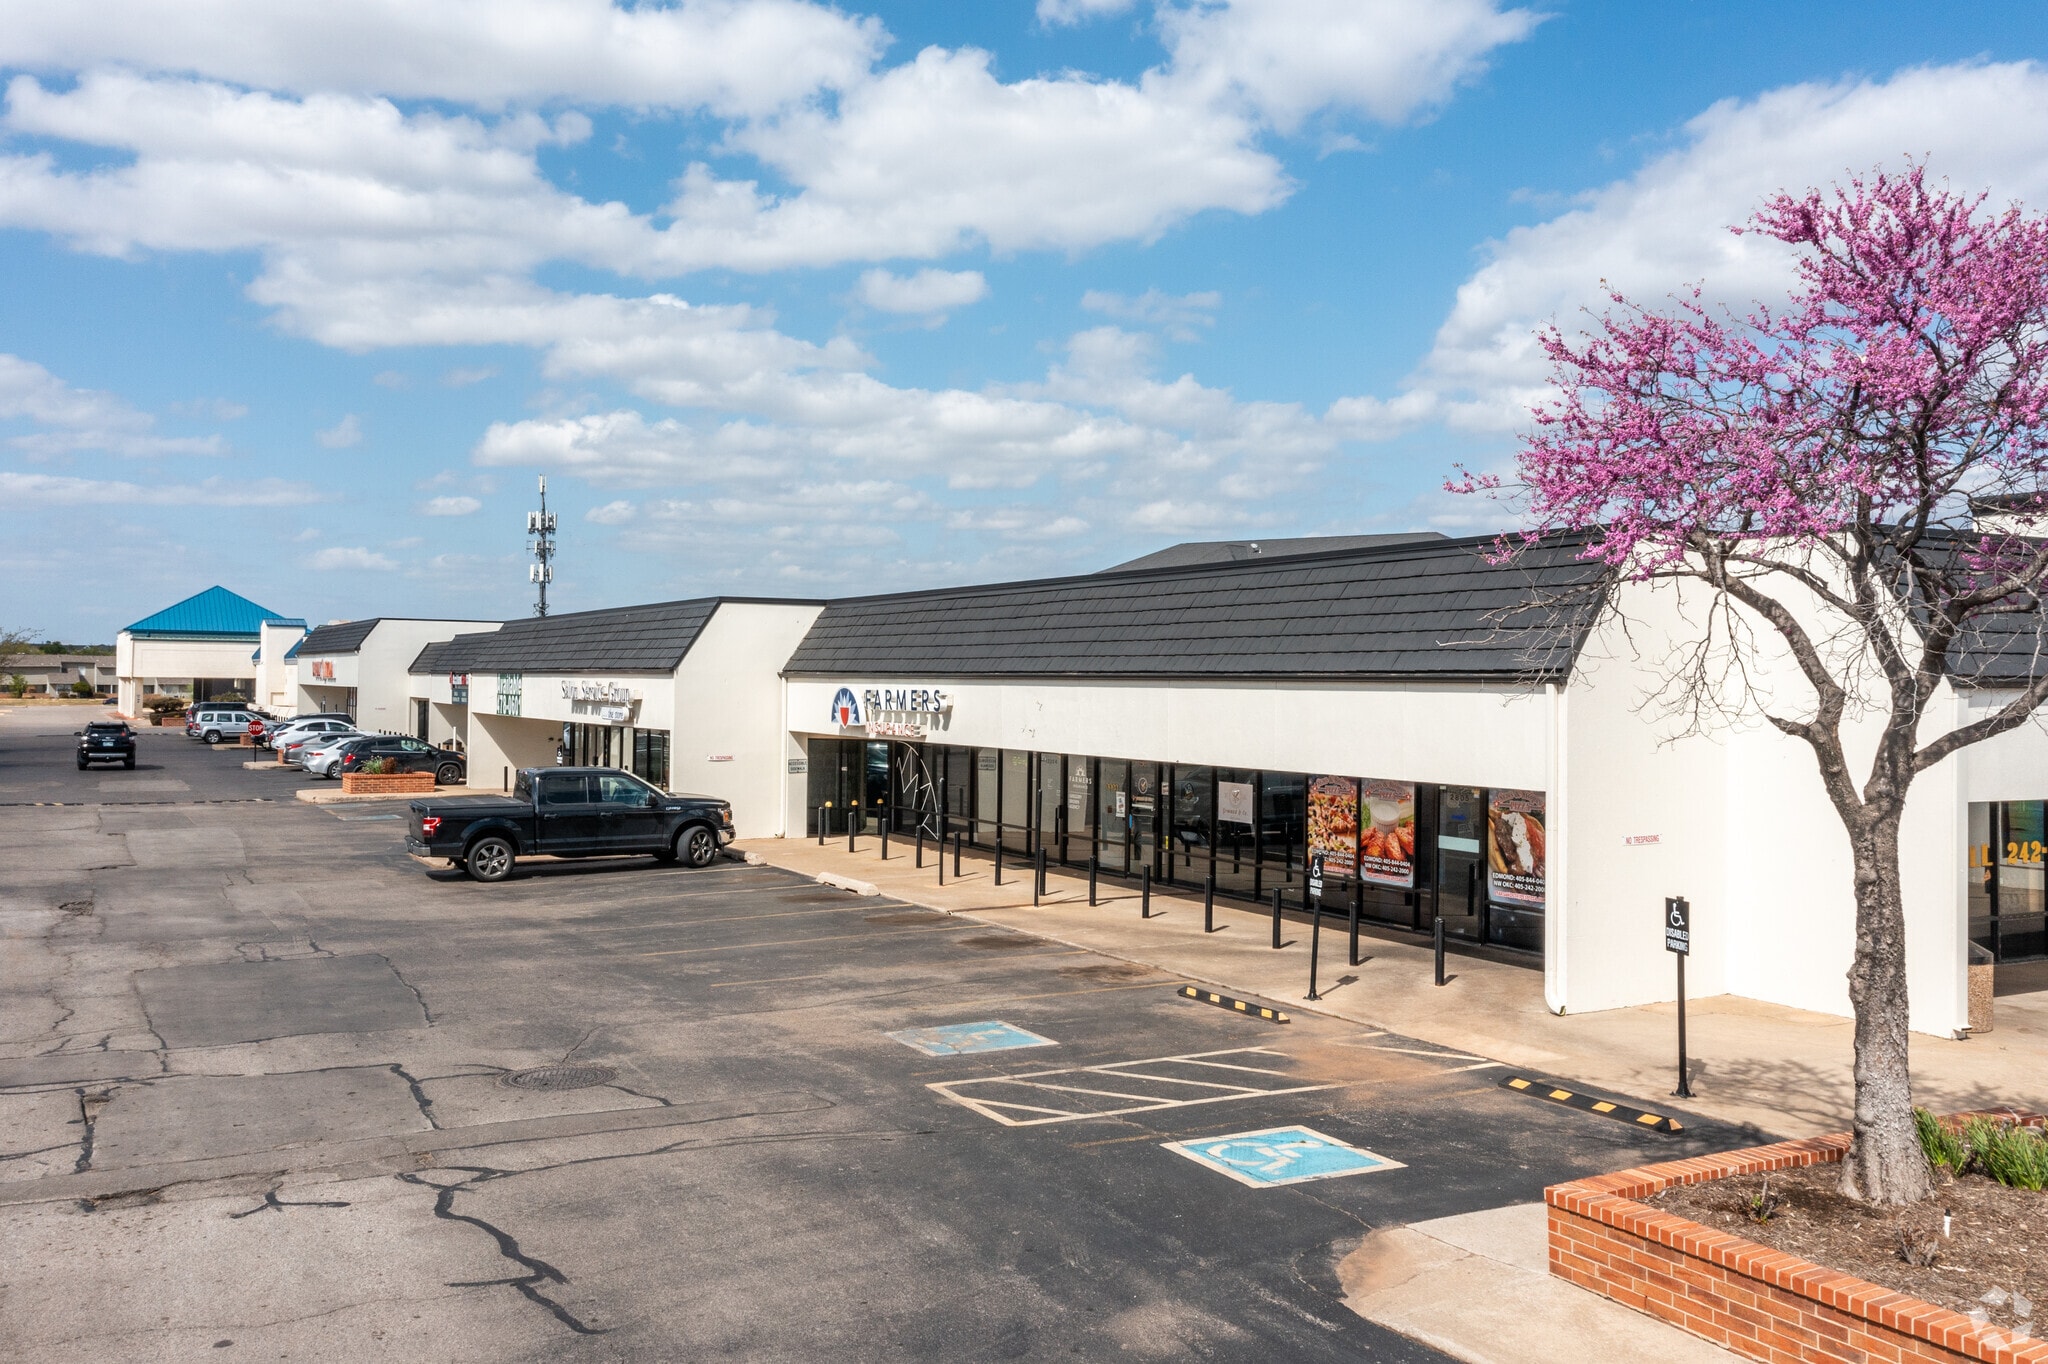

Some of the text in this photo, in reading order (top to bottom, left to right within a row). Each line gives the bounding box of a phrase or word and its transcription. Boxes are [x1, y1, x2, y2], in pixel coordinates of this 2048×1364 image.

[865, 690, 941, 711] FARMERS
[866, 721, 916, 737] INSURANCE
[1625, 834, 1660, 844] NO TRESPASSING
[1363, 855, 1382, 863] EDMOND:
[2007, 840, 2048, 865] 242-
[1493, 872, 1545, 885] EDMOND: 405-844-040
[1515, 883, 1545, 892] 405-242-200
[1666, 927, 1689, 940] DISABLED
[1667, 938, 1688, 952] PARKING
